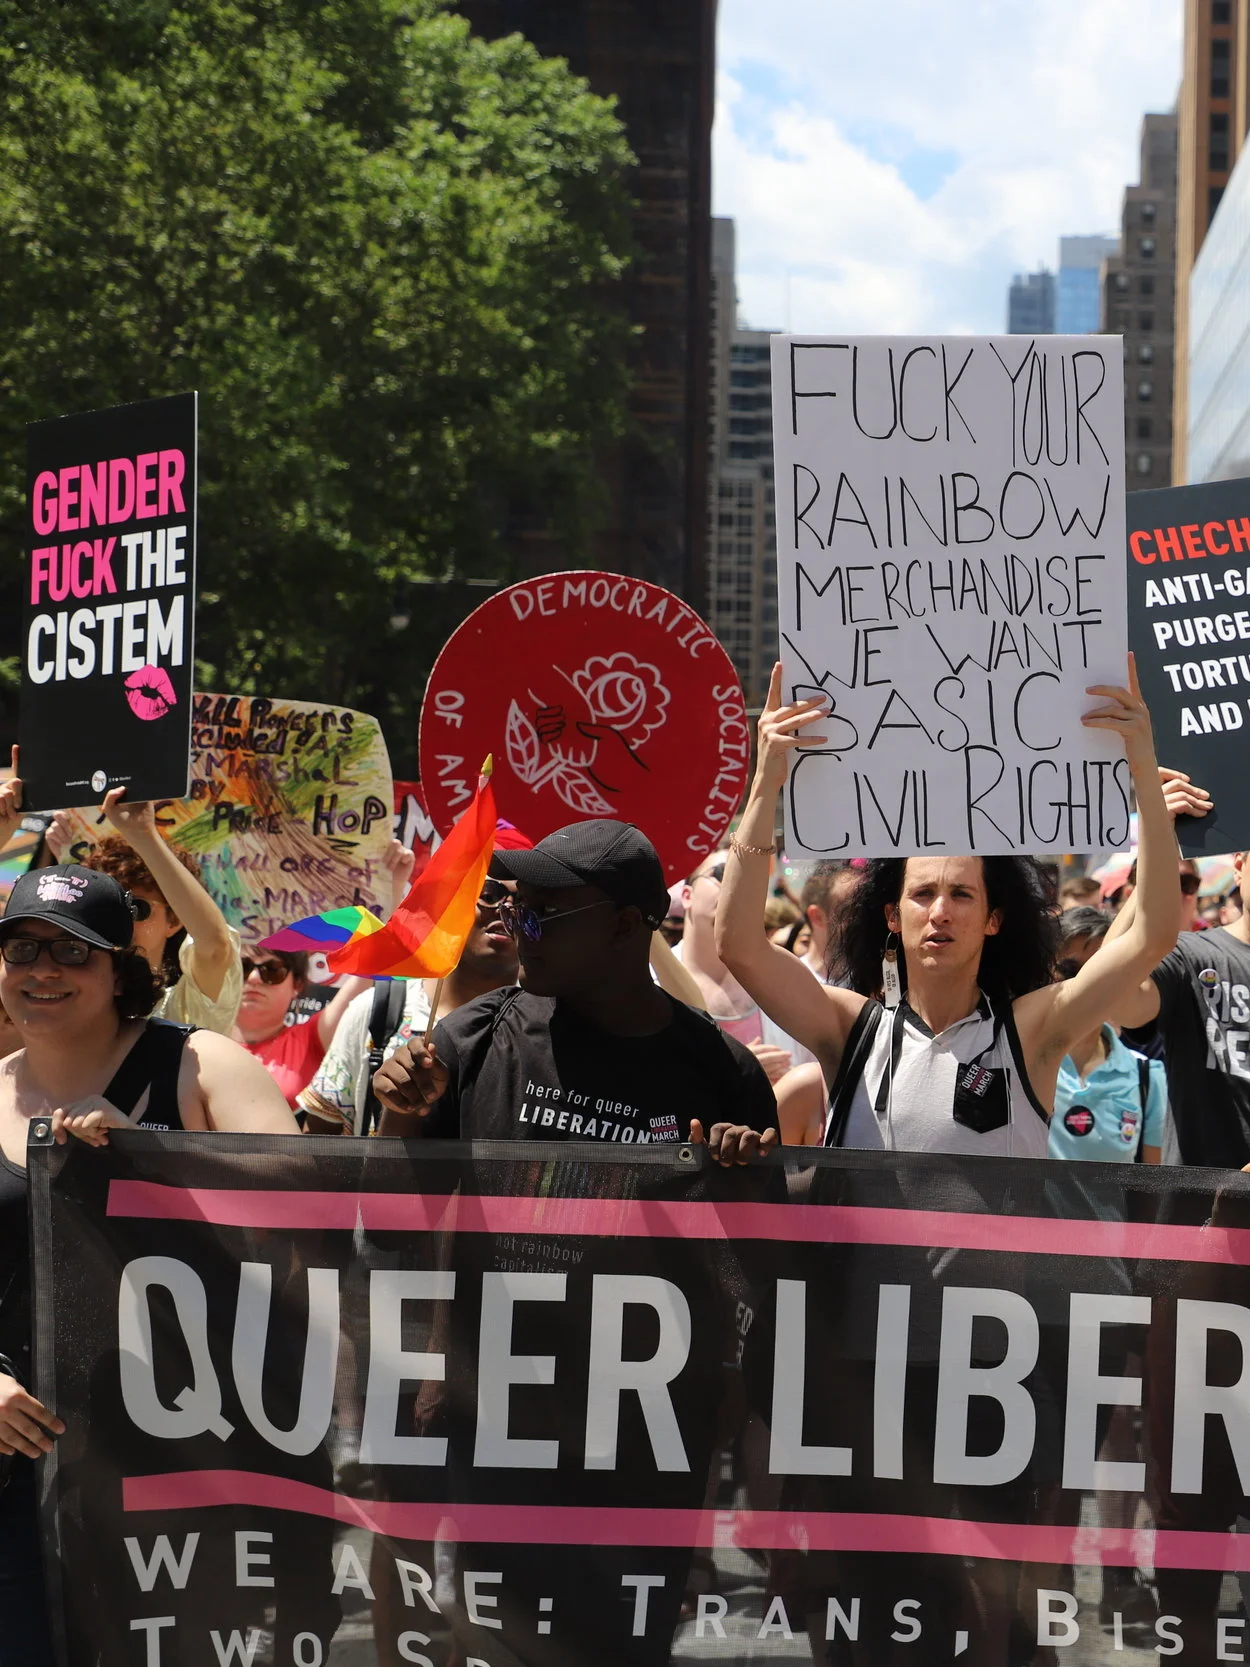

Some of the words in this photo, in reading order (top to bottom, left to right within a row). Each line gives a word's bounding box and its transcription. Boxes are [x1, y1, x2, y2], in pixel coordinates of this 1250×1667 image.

[789, 342, 977, 444] FUCK
[988, 339, 1110, 467] YOUR
[32, 447, 187, 536] GENDER
[793, 463, 1111, 550] RAINBOW
[30, 537, 118, 605] FUCK
[120, 526, 187, 592] THE
[795, 554, 1106, 631] MERCHANDISE
[27, 594, 185, 685] CISTEM
[509, 577, 718, 659] DEMOCRATIC
[781, 624, 899, 690] WE
[924, 620, 1102, 676] WANT
[434, 690, 465, 729] OF
[791, 671, 1062, 753] BASIC
[1179, 702, 1244, 737] AND
[686, 683, 746, 855] SOCIALISTS
[789, 751, 946, 852] CIVIL
[964, 744, 1130, 850] RIGHTS
[525, 1080, 561, 1101] here
[567, 1089, 591, 1107] for
[595, 1098, 640, 1118] queer
[961, 1063, 981, 1089] QUEER
[973, 1070, 993, 1096] MARCH
[518, 1102, 652, 1144] LIBERATION
[650, 1115, 677, 1129] QUEER
[652, 1130, 680, 1143] MARCH
[521, 1239, 584, 1265] rainbow
[119, 1256, 692, 1472] QUEER
[123, 1530, 276, 1593] WE
[330, 1543, 554, 1635] ARE:
[621, 1574, 969, 1657] TRANS,
